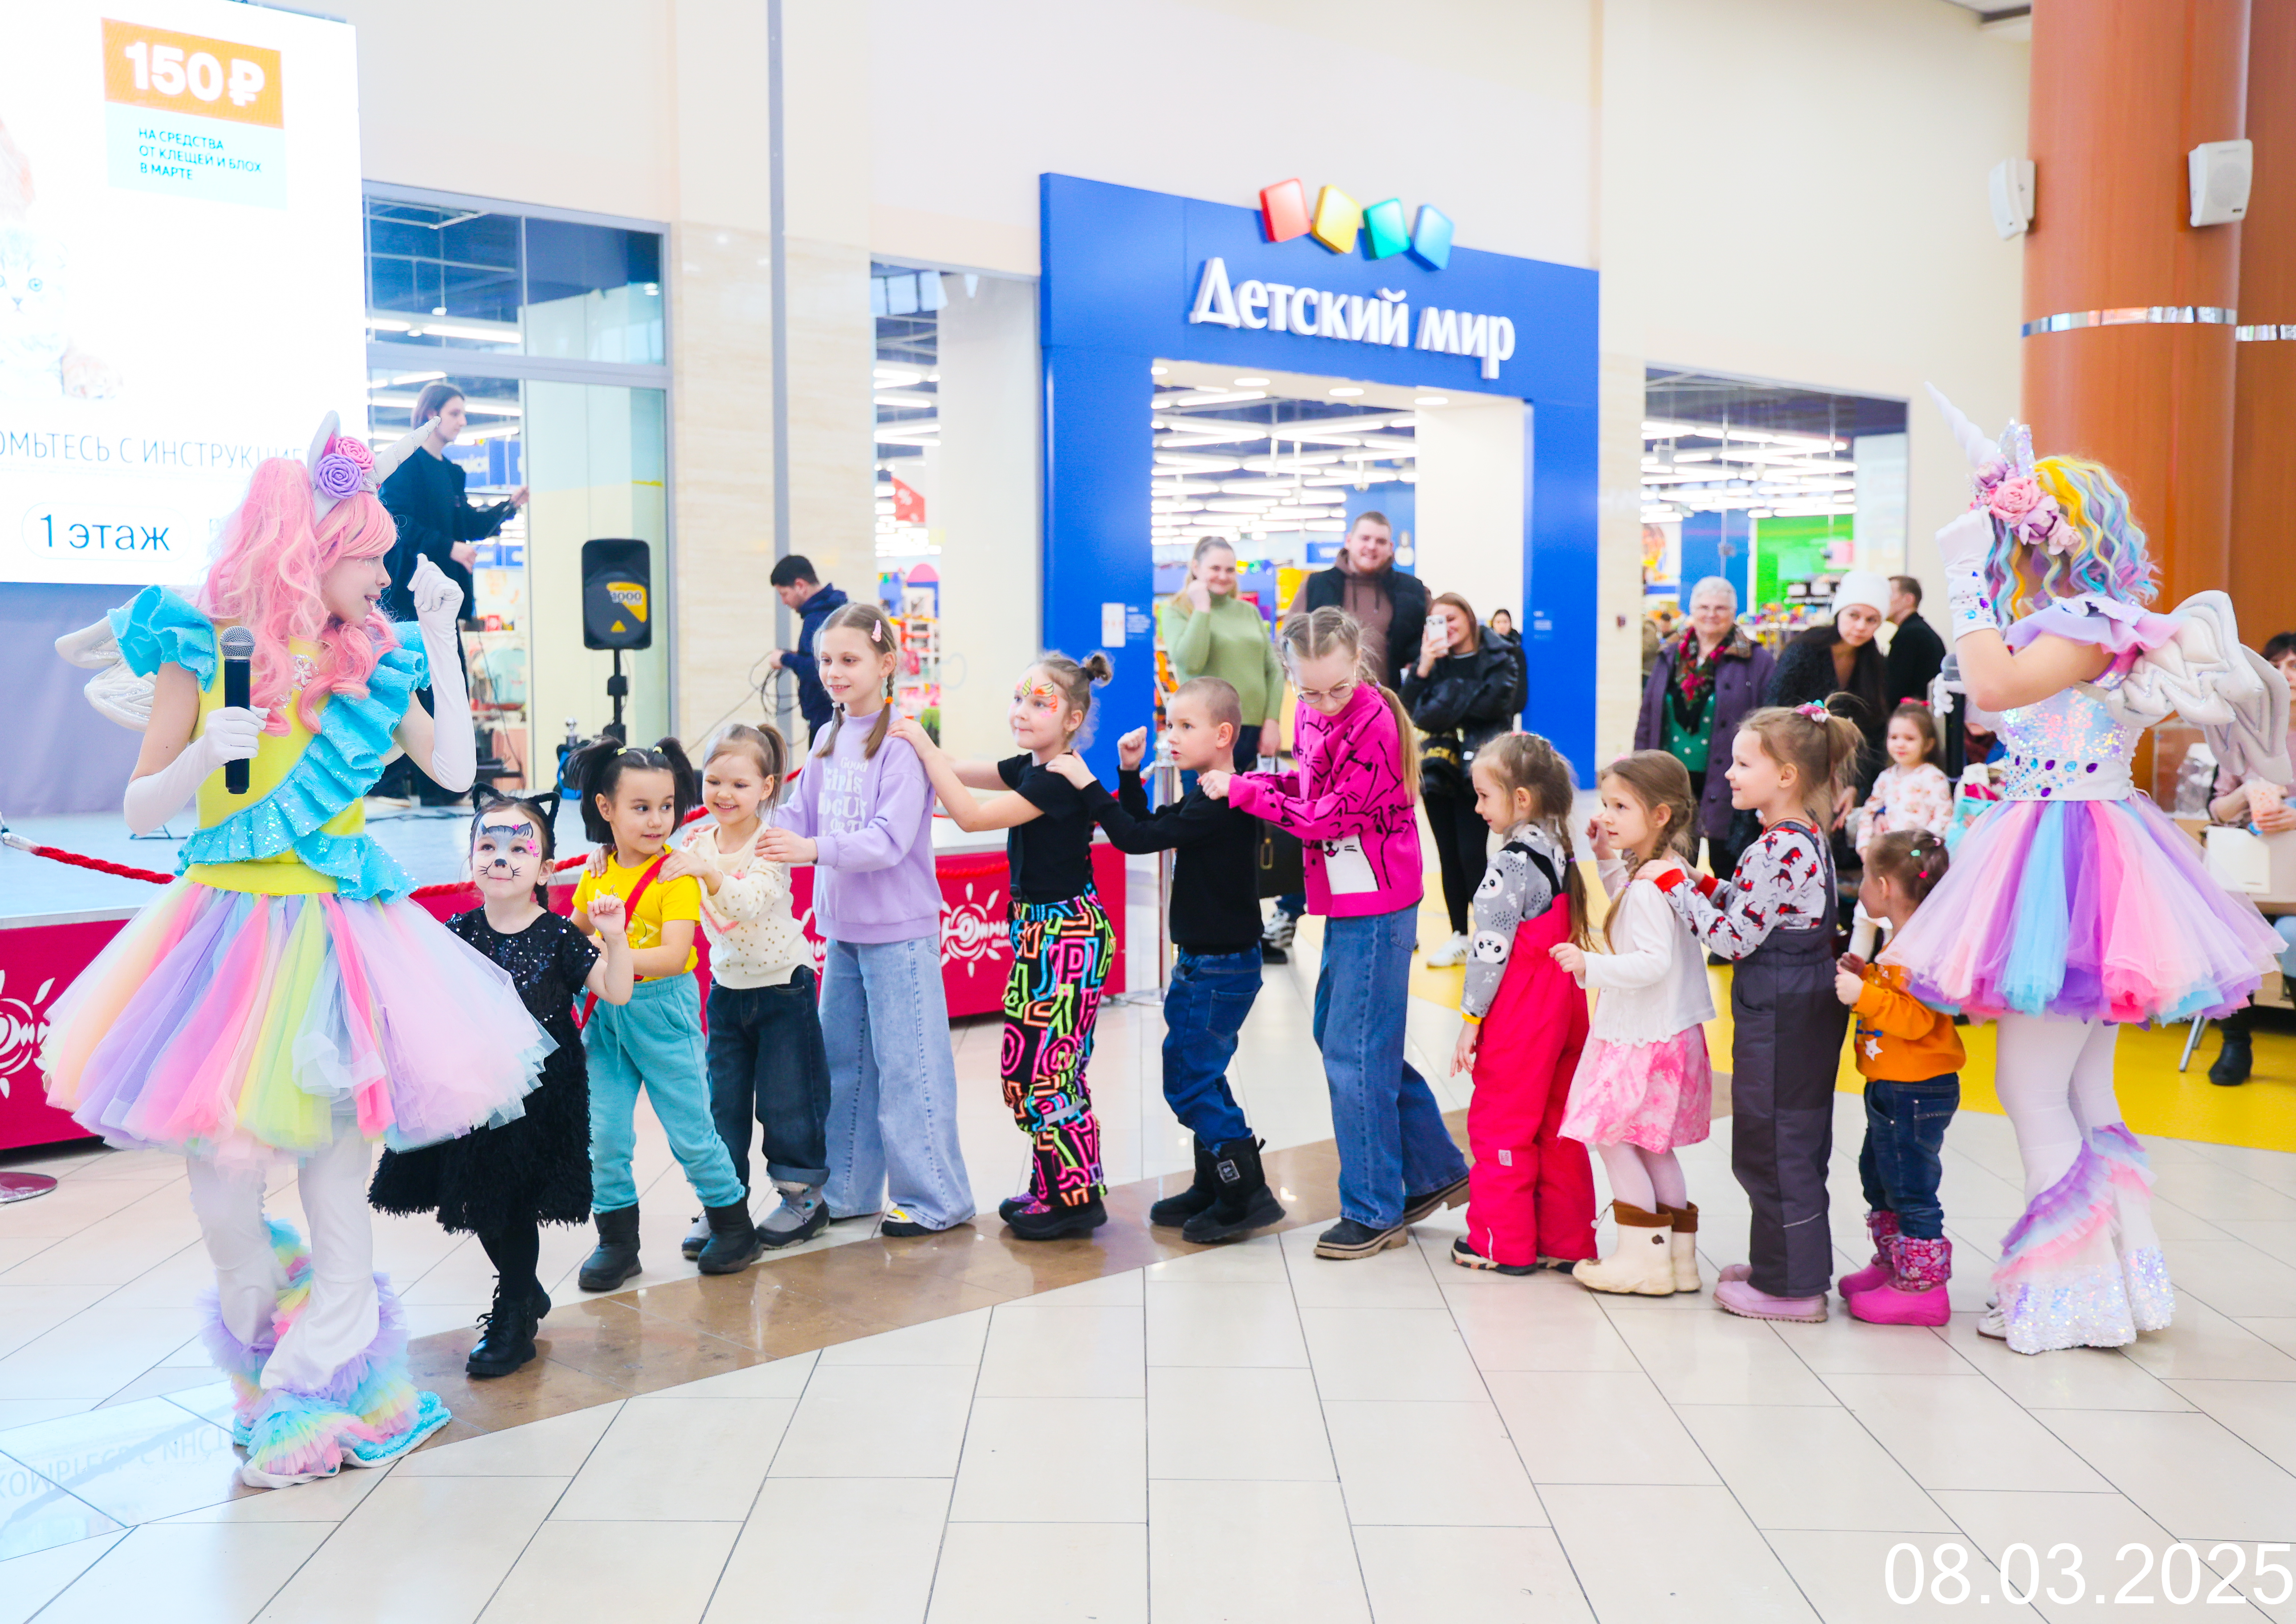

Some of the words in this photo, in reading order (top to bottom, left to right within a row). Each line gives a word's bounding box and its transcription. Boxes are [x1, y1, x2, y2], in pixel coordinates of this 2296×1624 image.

[138, 127, 156, 140] НА
[159, 131, 224, 150] СРЕДСТВА
[139, 145, 156, 157] ОТ
[159, 148, 214, 166] КЛЕЩЕЙ
[217, 156, 226, 167] И
[229, 158, 262, 173] БЛОХ
[140, 162, 148, 174] В
[151, 164, 193, 180] МАРТЕ
[1189, 256, 1409, 348] Детский
[1414, 304, 1516, 380] мир
[120, 438, 133, 463] С
[40, 514, 53, 548] 1
[68, 523, 171, 551] этаж
